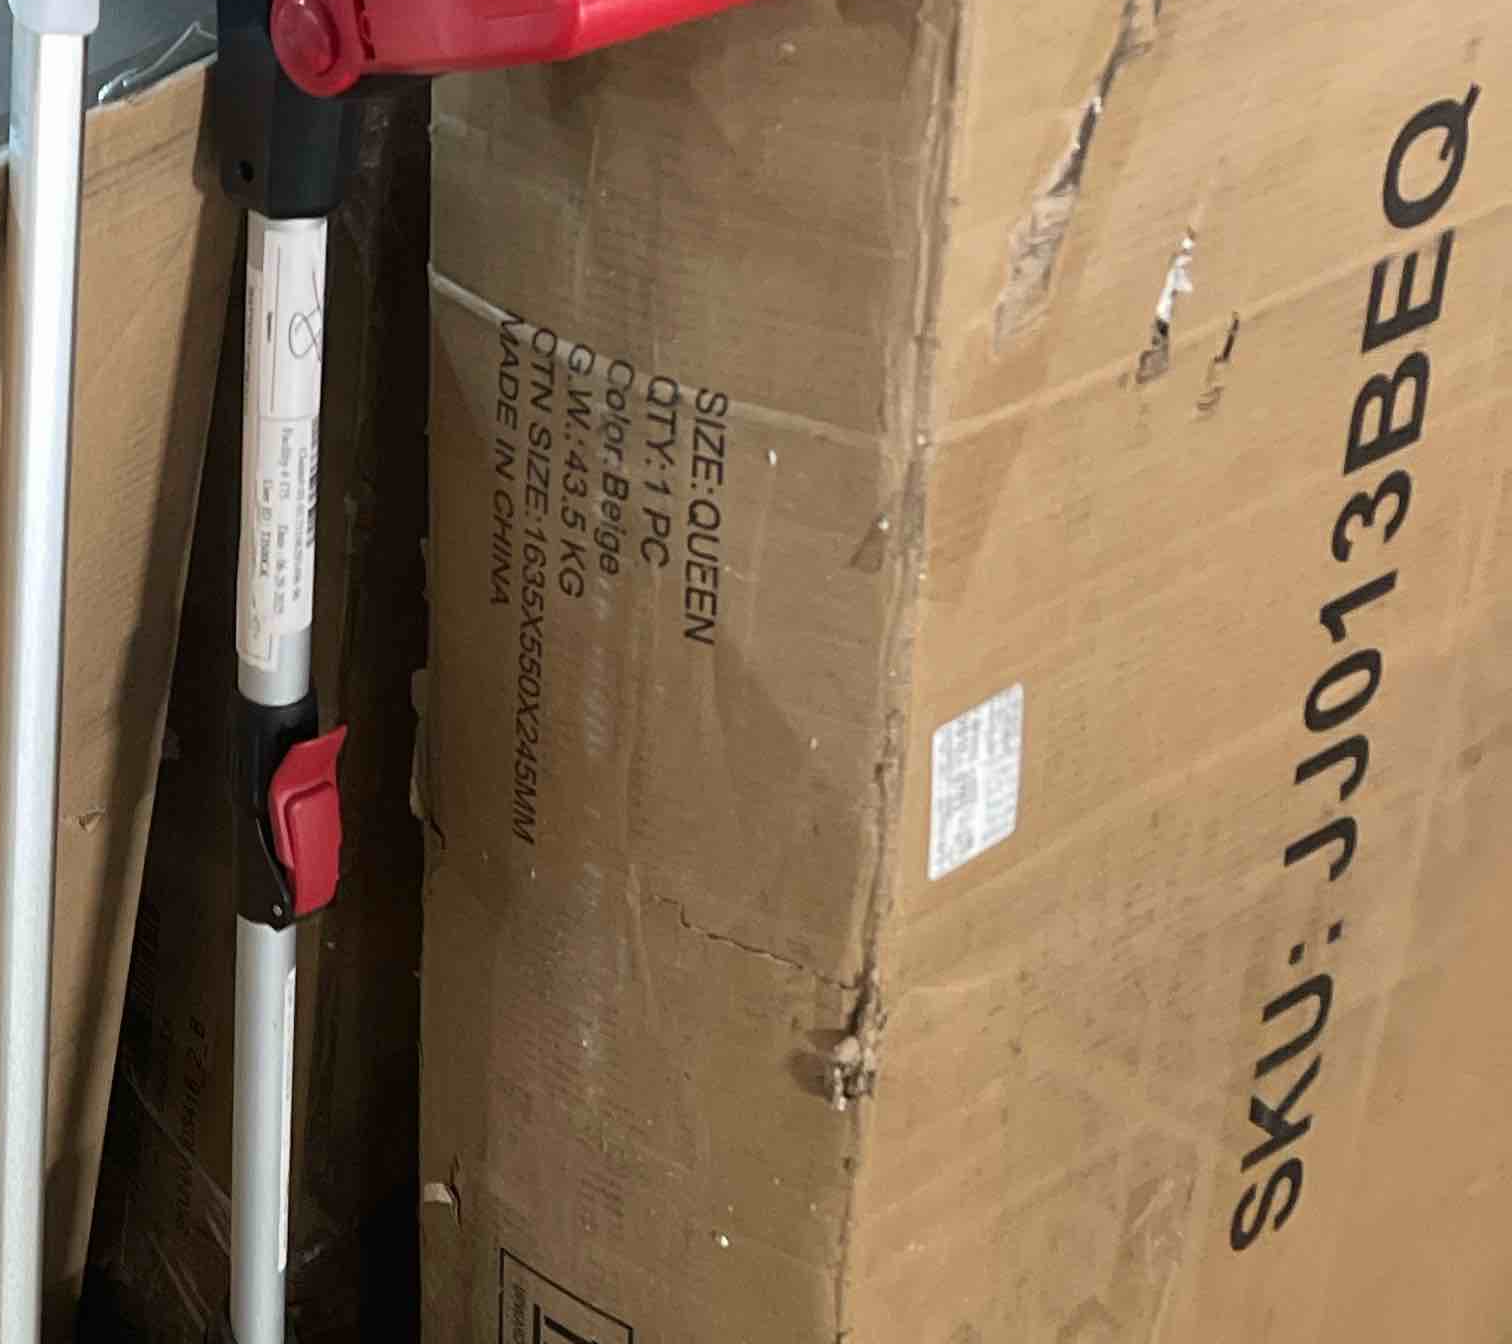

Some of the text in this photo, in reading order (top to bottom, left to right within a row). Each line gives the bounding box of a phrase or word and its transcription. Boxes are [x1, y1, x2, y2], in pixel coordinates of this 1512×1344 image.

[527, 327, 559, 408] CTN
[490, 312, 527, 606] MADE IN CHINA
[559, 543, 586, 600] KG
[640, 507, 672, 568] PC
